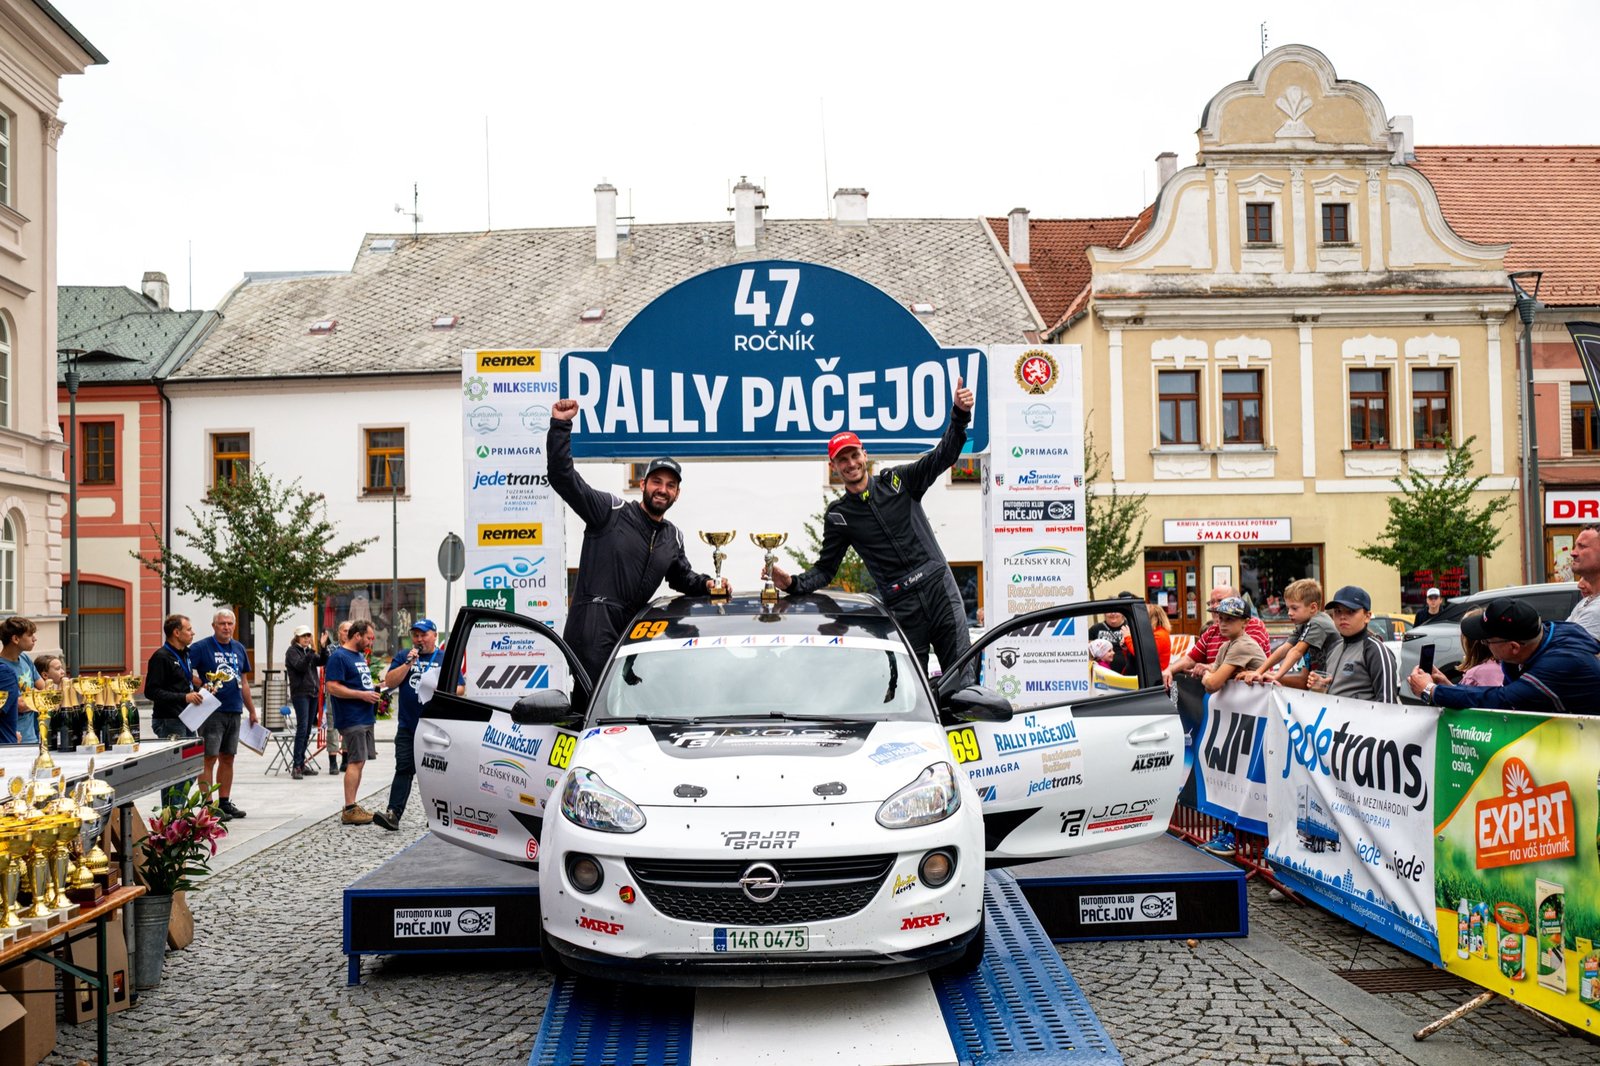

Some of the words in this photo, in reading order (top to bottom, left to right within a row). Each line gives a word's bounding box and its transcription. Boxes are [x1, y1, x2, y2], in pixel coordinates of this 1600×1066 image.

[734, 268, 815, 326] 47.
[735, 330, 815, 352] ROČNÍK
[493, 382, 558, 393] MILKSERVIS
[568, 355, 729, 434] RALLY
[742, 351, 980, 434] PAČEJOV
[491, 447, 541, 456] PRIMAGRA
[1025, 448, 1068, 456] PRIMAGRA
[1004, 508, 1043, 520] PAČEJOV
[1197, 529, 1259, 540] ŠMAKOUN
[1004, 556, 1048, 566] PLZEŇSKÝ
[1050, 557, 1070, 567] KRAJ
[483, 575, 546, 590] EPLcond
[630, 621, 669, 639] 69
[1057, 649, 1088, 657] KANCELÁŘ
[1026, 681, 1089, 692] MILKSERVIS
[1024, 716, 1041, 729] 47.
[482, 725, 506, 746] RALLY
[506, 734, 543, 756] PAČEJOV
[993, 732, 1028, 752] RALLY
[1030, 721, 1077, 746] PAČEJOV
[1448, 724, 1492, 744] Trávníková
[550, 734, 577, 769] 69
[947, 728, 980, 764] 69
[421, 756, 448, 772] ALSTAV
[969, 762, 1020, 779] PRIMAGRA
[1131, 754, 1175, 772] ALSTAV
[479, 764, 511, 783] PLZEŇSKÝ
[512, 776, 527, 789] KRAJ
[1363, 797, 1409, 817] MEZINÁRODNÍ
[1479, 790, 1568, 850] EXPERT
[733, 840, 797, 850] SPORT
[1509, 850, 1520, 862] na
[1522, 843, 1537, 860] váš
[1539, 838, 1570, 857] trávník
[1081, 896, 1116, 906] AUTOMOTO
[1117, 895, 1134, 904] KLUB
[396, 909, 432, 919] AUTOMOTO
[434, 909, 452, 918] KLUB
[900, 912, 946, 931] MRF
[1081, 905, 1134, 922] PAČEJOV
[396, 918, 451, 936] PAČEJOV
[578, 915, 624, 936] MRF
[729, 931, 759, 949] 14R
[764, 930, 805, 949] 0475
